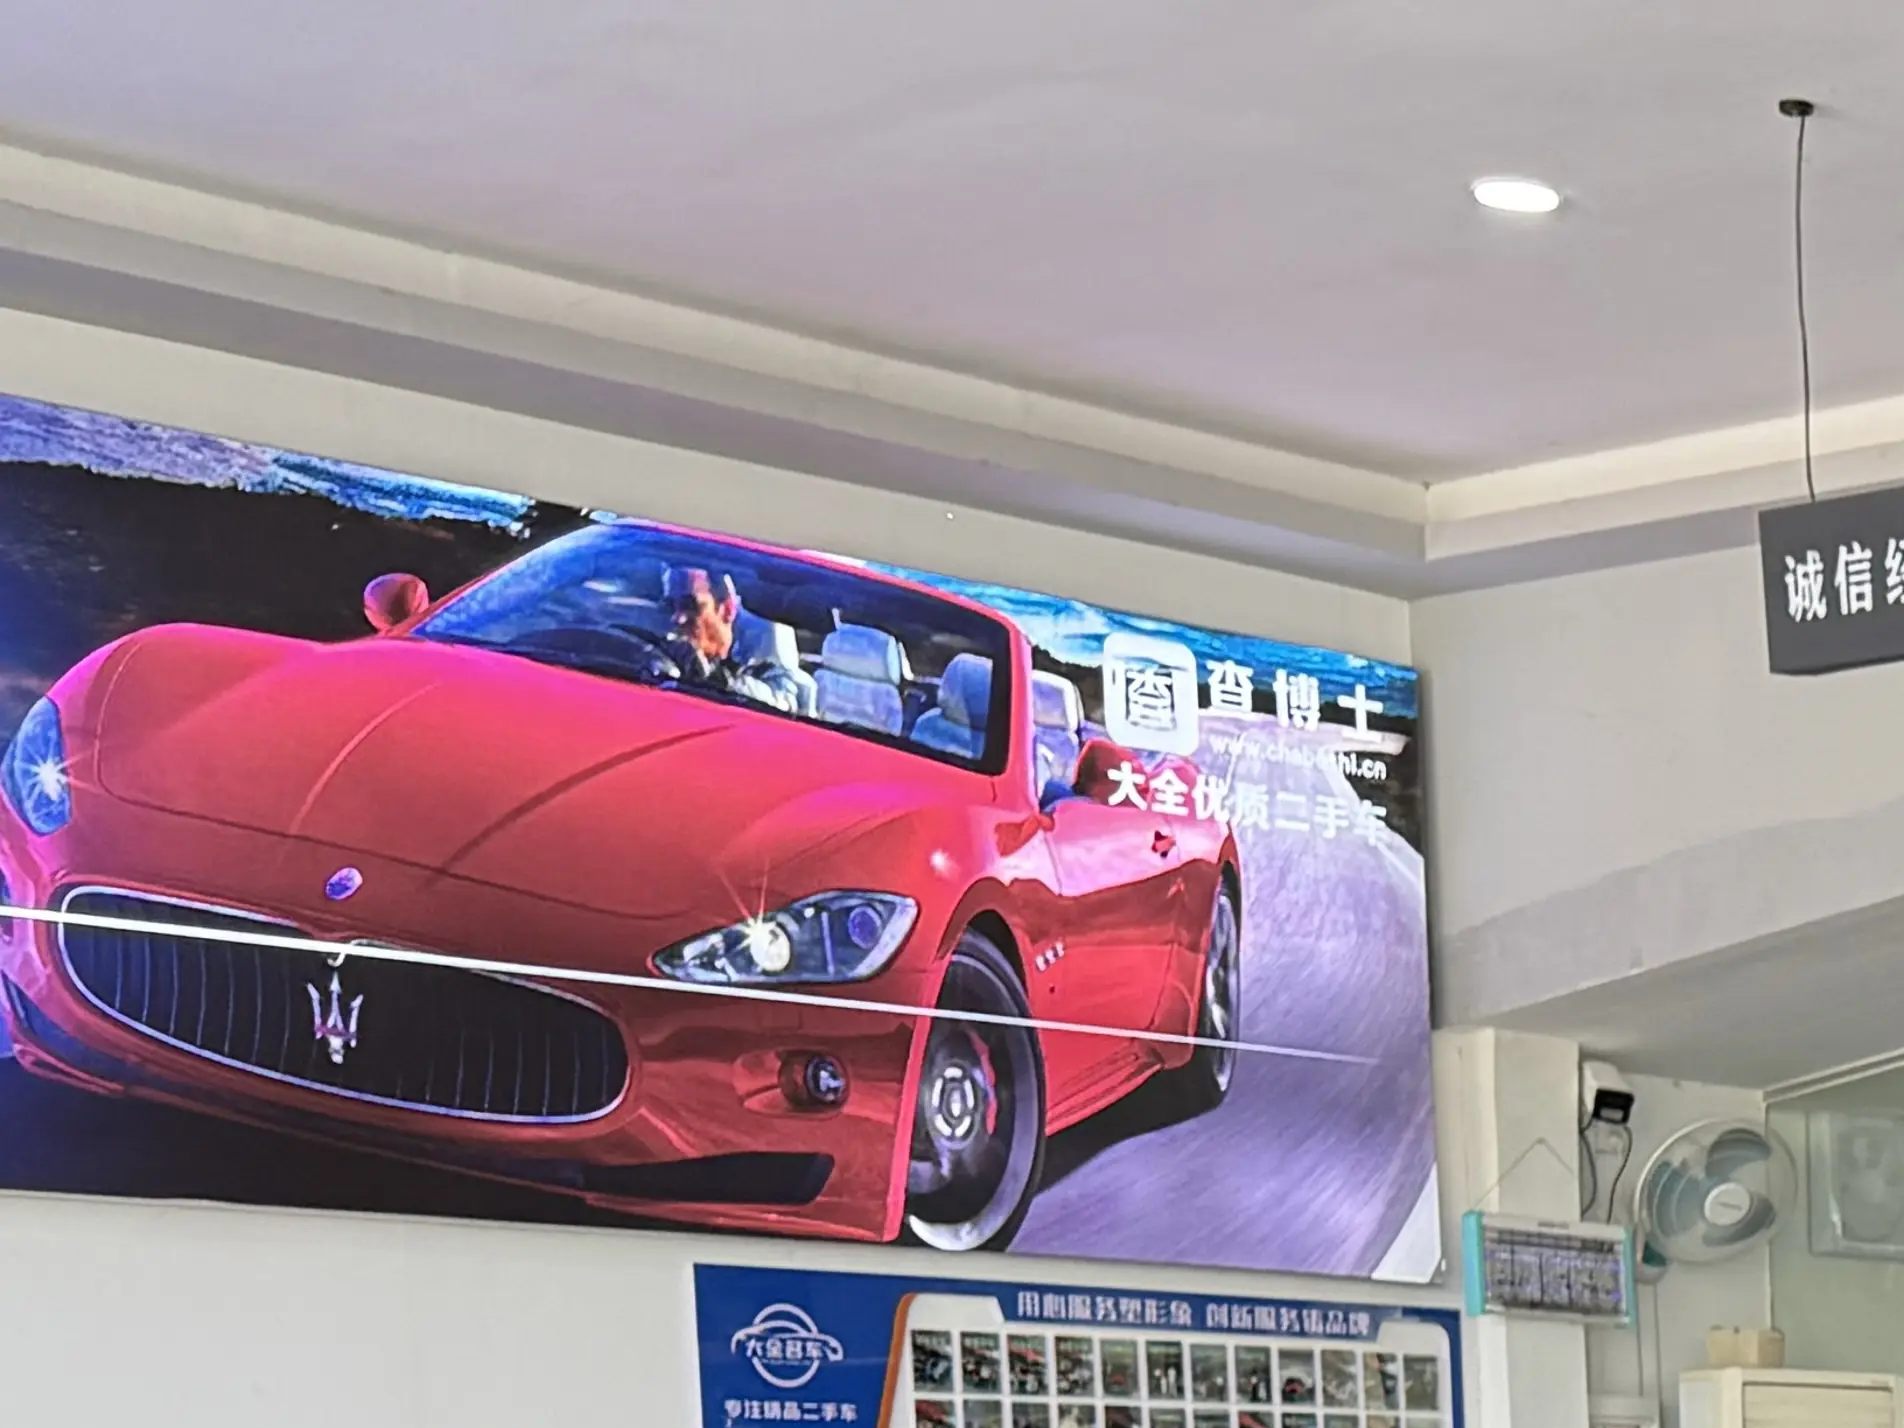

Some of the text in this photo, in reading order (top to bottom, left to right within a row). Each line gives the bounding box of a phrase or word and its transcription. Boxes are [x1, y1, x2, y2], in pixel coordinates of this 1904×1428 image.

[1206, 659, 1385, 743] 查博士
[1107, 761, 1388, 847] 大全优质二手车
